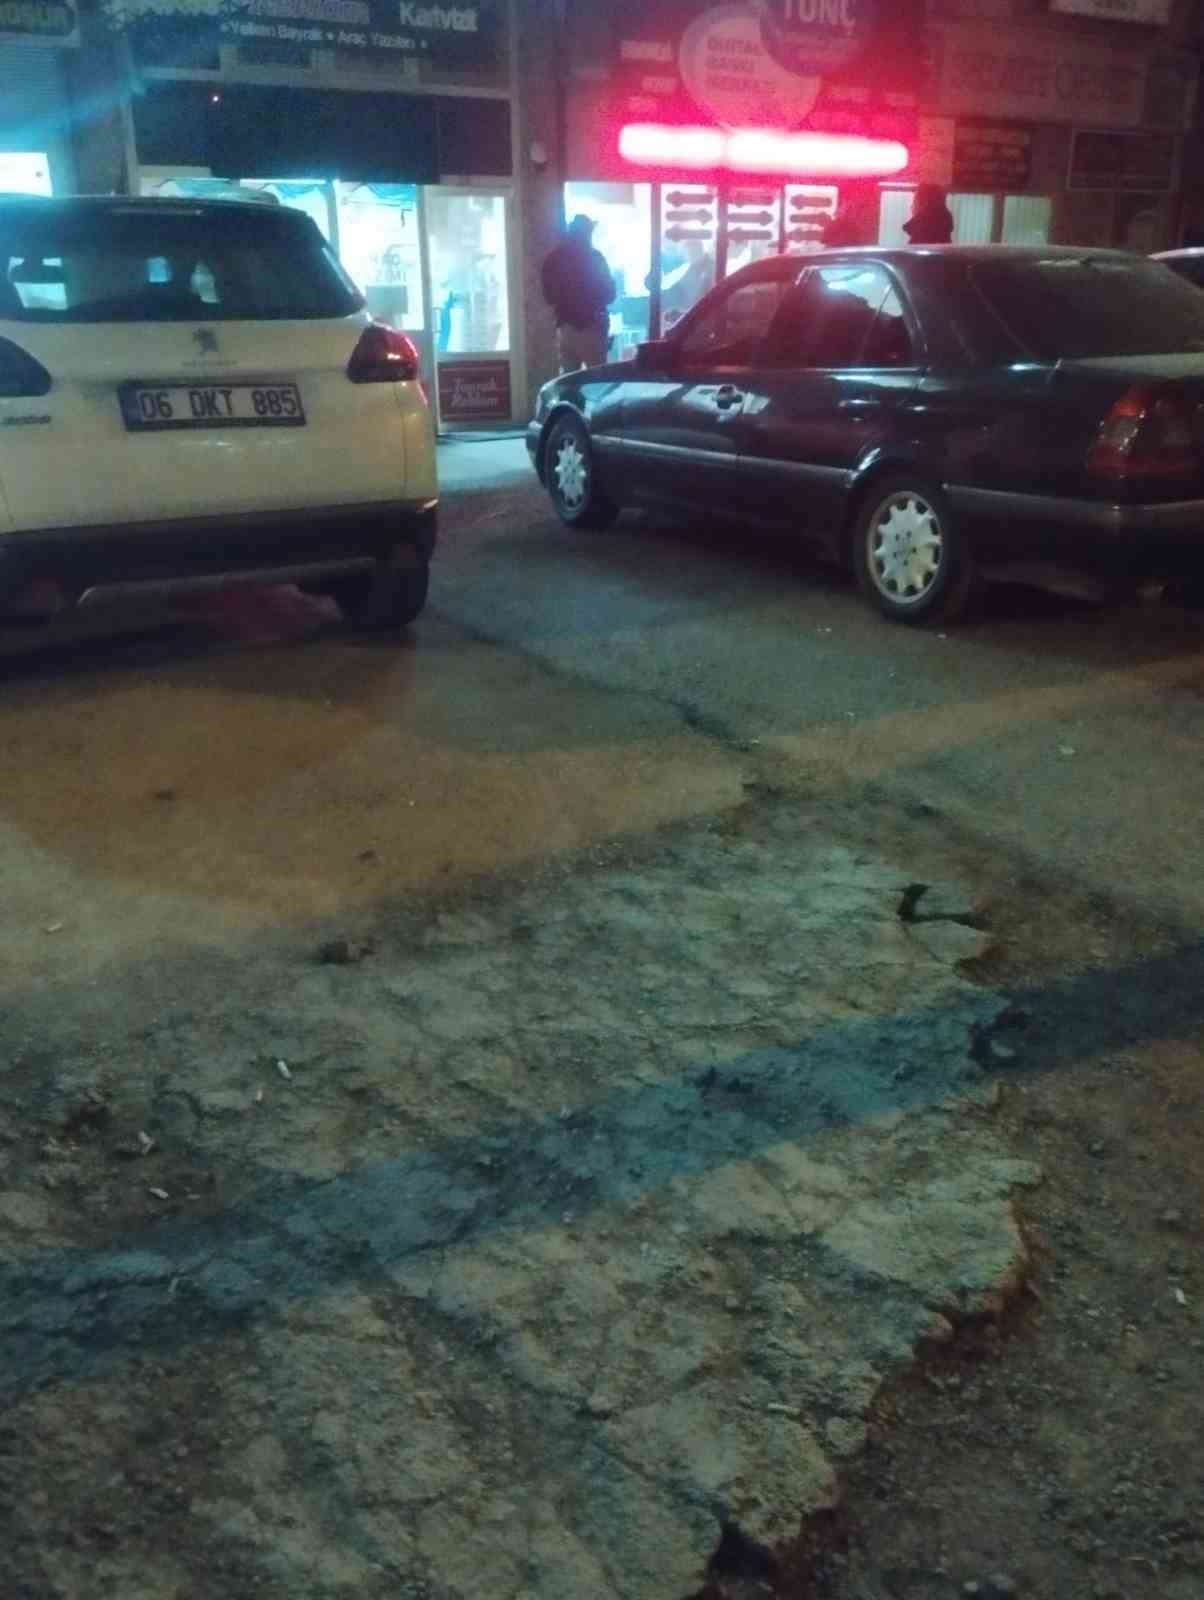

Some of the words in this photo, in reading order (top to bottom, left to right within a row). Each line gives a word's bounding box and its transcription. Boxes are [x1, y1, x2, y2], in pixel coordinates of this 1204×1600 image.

[139, 391, 173, 418] 06
[188, 389, 233, 417] DKT
[251, 388, 298, 416] 885
